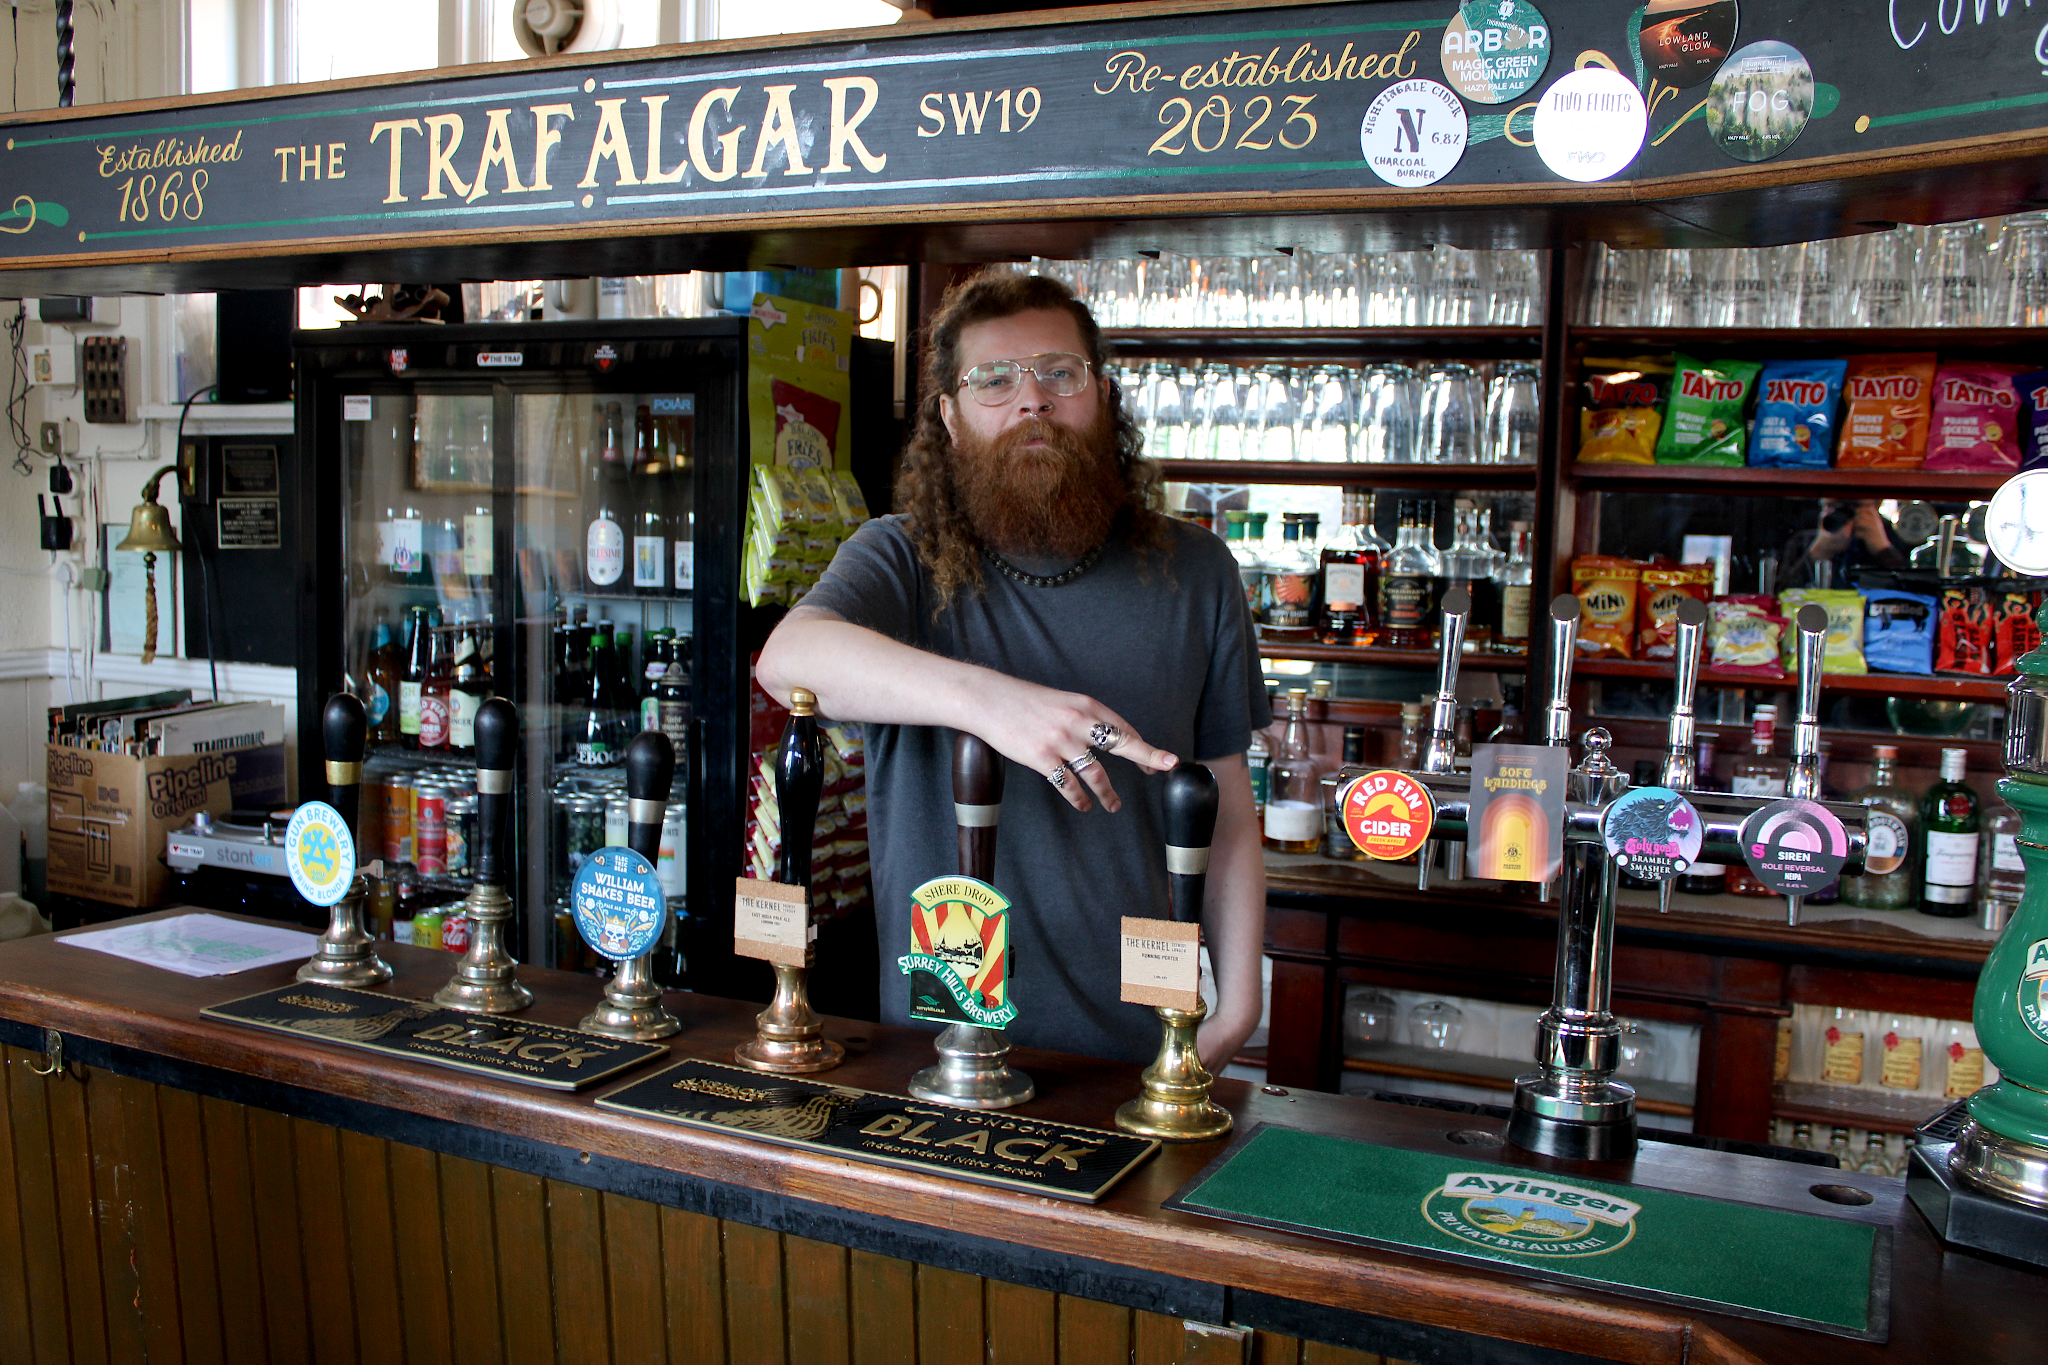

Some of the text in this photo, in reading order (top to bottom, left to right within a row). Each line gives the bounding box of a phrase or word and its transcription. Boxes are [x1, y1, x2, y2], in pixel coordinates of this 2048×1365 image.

[1659, 31, 1709, 47] LOWLAND
[1681, 40, 1712, 53] GLOW
[1094, 30, 1421, 95] Re-established
[1452, 55, 1538, 72] MAGIC GREEN
[1460, 67, 1529, 82] MOUNTAIN
[1464, 81, 1525, 93] HAZY PALE ALE
[918, 86, 1042, 138] SW19
[1364, 81, 1462, 135] NIGHTINGALE CIDER
[1553, 91, 1632, 113] TWO FLINTS
[1732, 89, 1789, 113] FOG
[1147, 93, 1318, 157] 2023
[1393, 108, 1427, 153] N
[369, 76, 887, 204] TRAFALGAR
[1431, 132, 1461, 146] 6.8%
[96, 130, 243, 178] Established
[274, 143, 347, 183] THE
[1374, 156, 1427, 167] CHARCOAL
[1396, 168, 1436, 180] BURNER
[117, 169, 209, 222] 1868
[802, 329, 838, 353] FRIES
[1681, 368, 1745, 402] TAYTO
[1765, 378, 1829, 407] TAYTO
[1849, 374, 1922, 401] TAYTO
[1941, 378, 2015, 409] TAYTO
[1675, 411, 1706, 424] SPRING
[1675, 421, 1702, 431] ONION
[1853, 414, 1884, 425] SMOKY
[790, 424, 821, 443] BACON
[1853, 424, 1883, 435] BACON
[787, 439, 824, 467] FRIES
[1580, 570, 1637, 578] GRAB BAG
[1587, 592, 1627, 611] MINI
[1653, 593, 1684, 611] MIN
[430, 701, 448, 720] FIN
[49, 750, 93, 778] Pipeline
[1499, 766, 1533, 779] SOFT
[147, 753, 238, 802] Pipeline
[1483, 776, 1548, 795] LANDINGS
[151, 785, 208, 820] Original
[1352, 776, 1423, 810] RED FIN
[288, 815, 306, 848] GUN
[306, 807, 351, 863] BREWERY
[1360, 820, 1412, 838] CIDER
[217, 847, 274, 868] stanton
[1631, 854, 1672, 866] BRAMBLE
[1751, 843, 1766, 859] S
[1777, 851, 1811, 862] SIREN
[1630, 863, 1671, 874] SMASHER
[1638, 870, 1662, 881] 5.5%
[1761, 862, 1827, 874] ROLE REVERSAL
[1784, 872, 1802, 881] NEIPA
[291, 863, 316, 897] SPRING
[318, 876, 345, 900] BLONDE
[594, 871, 645, 894] WILLIAM
[581, 882, 656, 910] SHAKES BEER
[741, 897, 754, 908] THE
[755, 899, 781, 912] KERNEL
[924, 884, 994, 907] SHERE DROP
[1125, 937, 1140, 949] THE
[1141, 939, 1171, 952] KERNEL
[1141, 952, 1161, 960] RUNNING
[897, 955, 1013, 1025] SURREY HILLS BREWERY
[916, 1005, 946, 1014] surreyhills.co.uk
[412, 1023, 607, 1069] BLACK
[953, 1114, 1053, 1137] LONDON
[858, 1113, 1097, 1172] BLACK
[862, 1139, 1046, 1178] Independent Nitro Porter
[1454, 1175, 1629, 1215] Ayinger
[1437, 1210, 1607, 1253] PRIVATBRAUEREI
